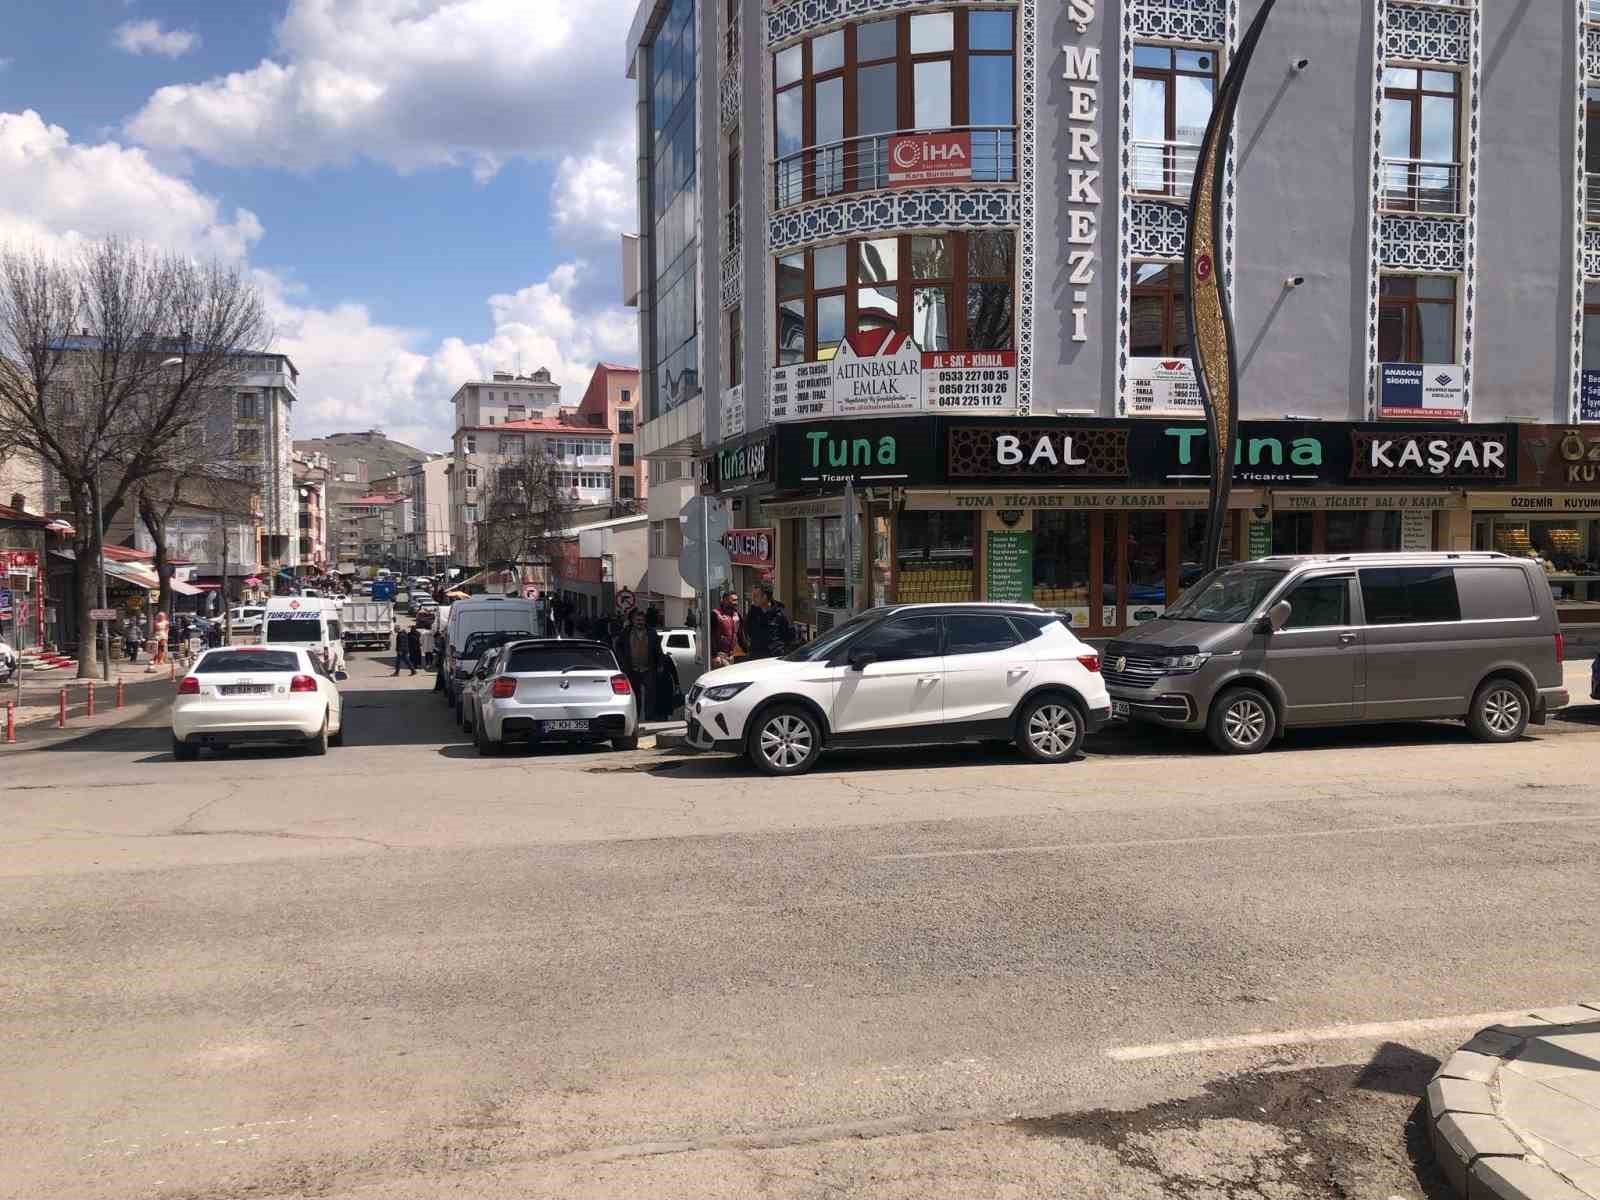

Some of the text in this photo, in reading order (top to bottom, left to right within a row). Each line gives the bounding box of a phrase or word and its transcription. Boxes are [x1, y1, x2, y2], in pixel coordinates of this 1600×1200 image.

[922, 142, 966, 161] İHA
[1061, 45, 1101, 342] MERKEZİ
[933, 355, 943, 368] AL
[950, 355, 966, 368] SAT
[972, 353, 1002, 367] KİRALA
[836, 359, 920, 380] ALTINBAŞLAR
[939, 370, 1009, 381] 0533 227 00 35
[853, 378, 900, 396] EMLAK
[1386, 376, 1420, 385] SİGORTA
[939, 383, 1007, 394] 0850 211 30 26
[939, 395, 1002, 406] 0474 225 11 12
[805, 431, 897, 468] Tuna
[995, 434, 1086, 466] BAL
[1370, 439, 1505, 475] KAŞAR
[719, 449, 745, 480] Tuna
[821, 473, 855, 482] Ticaret
[1240, 471, 1291, 481] Ticaret
[955, 496, 993, 506] TUNA
[1004, 494, 1065, 506] TİCARET
[1073, 495, 1100, 506] BAL
[1288, 496, 1316, 507] TUNA
[1325, 495, 1369, 507] TİCARET
[1375, 496, 1393, 507] BAL
